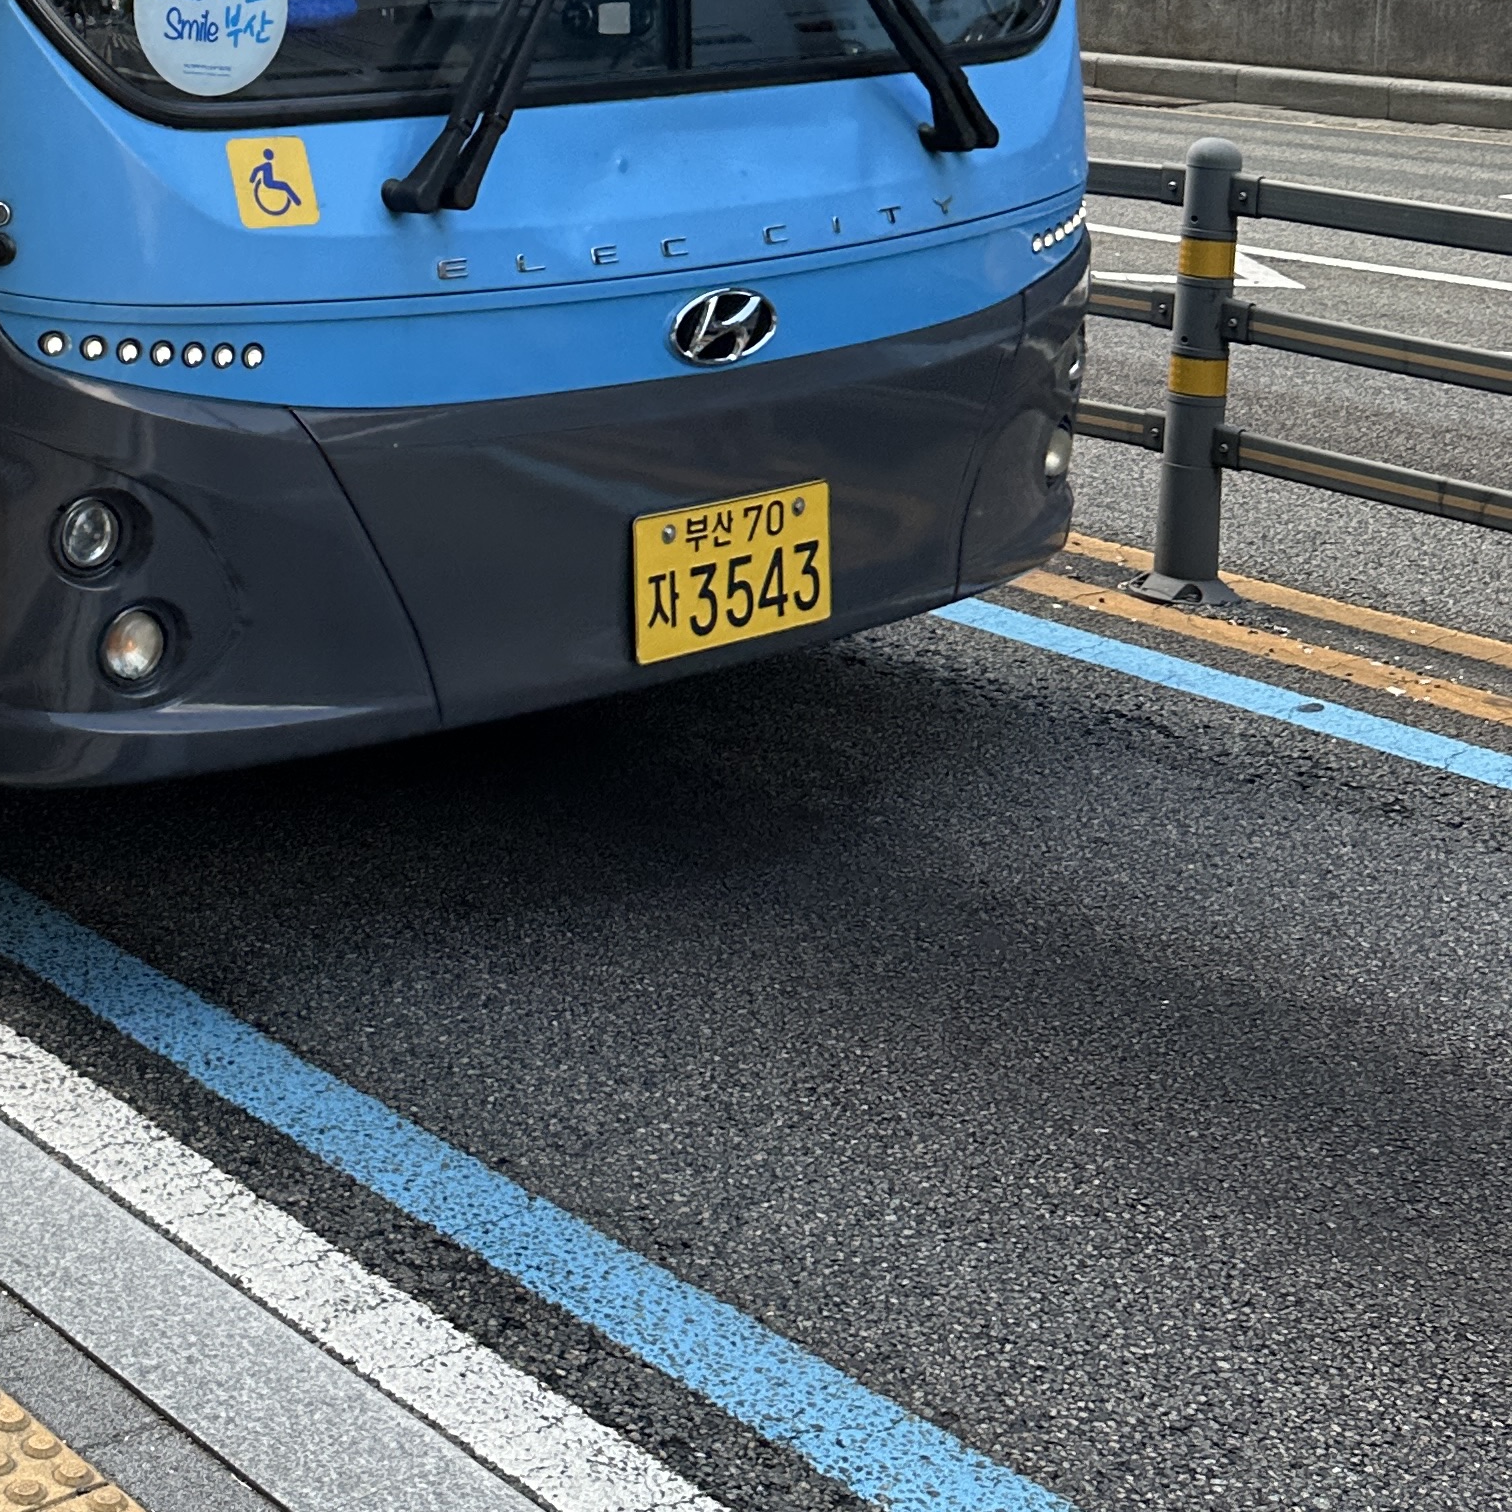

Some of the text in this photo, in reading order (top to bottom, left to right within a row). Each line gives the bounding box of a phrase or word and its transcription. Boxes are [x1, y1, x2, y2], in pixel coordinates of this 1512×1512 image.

[164, 4, 274, 48] Smile 부산
[437, 195, 953, 280] ELEC CITY
[685, 500, 785, 553] 부산 70
